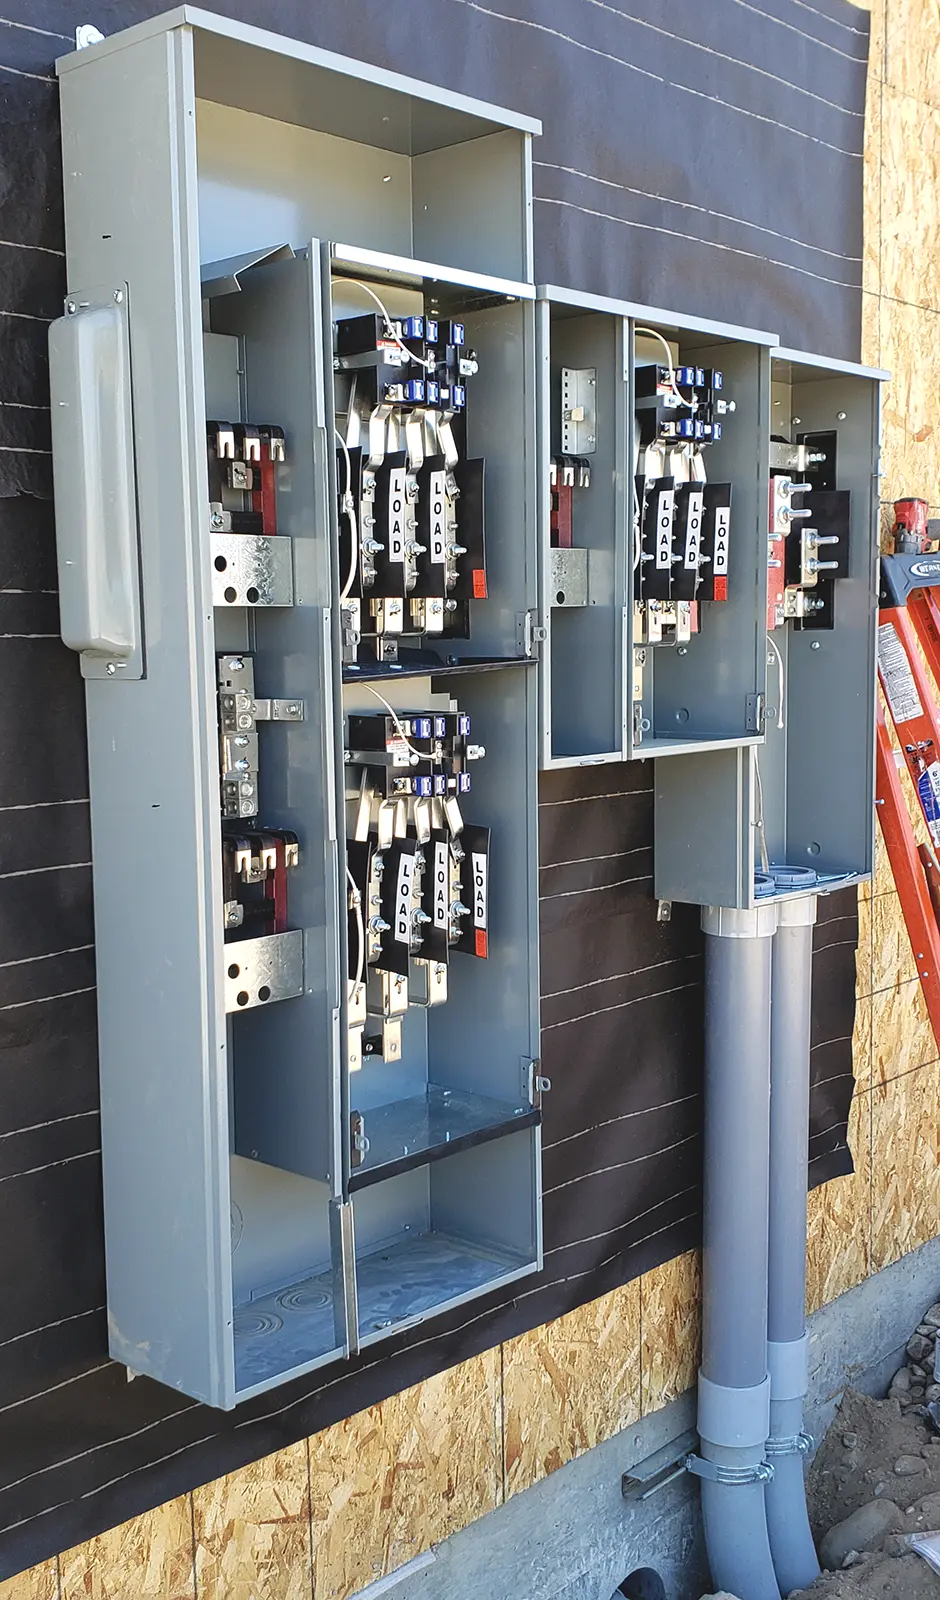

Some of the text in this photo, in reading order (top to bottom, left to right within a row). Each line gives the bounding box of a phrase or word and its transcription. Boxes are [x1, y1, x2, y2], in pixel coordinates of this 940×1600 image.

[393, 480, 401, 554] LOAD
[434, 482, 442, 555] LOAD
[661, 499, 669, 562] LOAD
[689, 501, 698, 562] LOAD
[716, 514, 726, 566] LOAD
[399, 864, 409, 934] LOAD
[475, 861, 484, 918] LOAD
